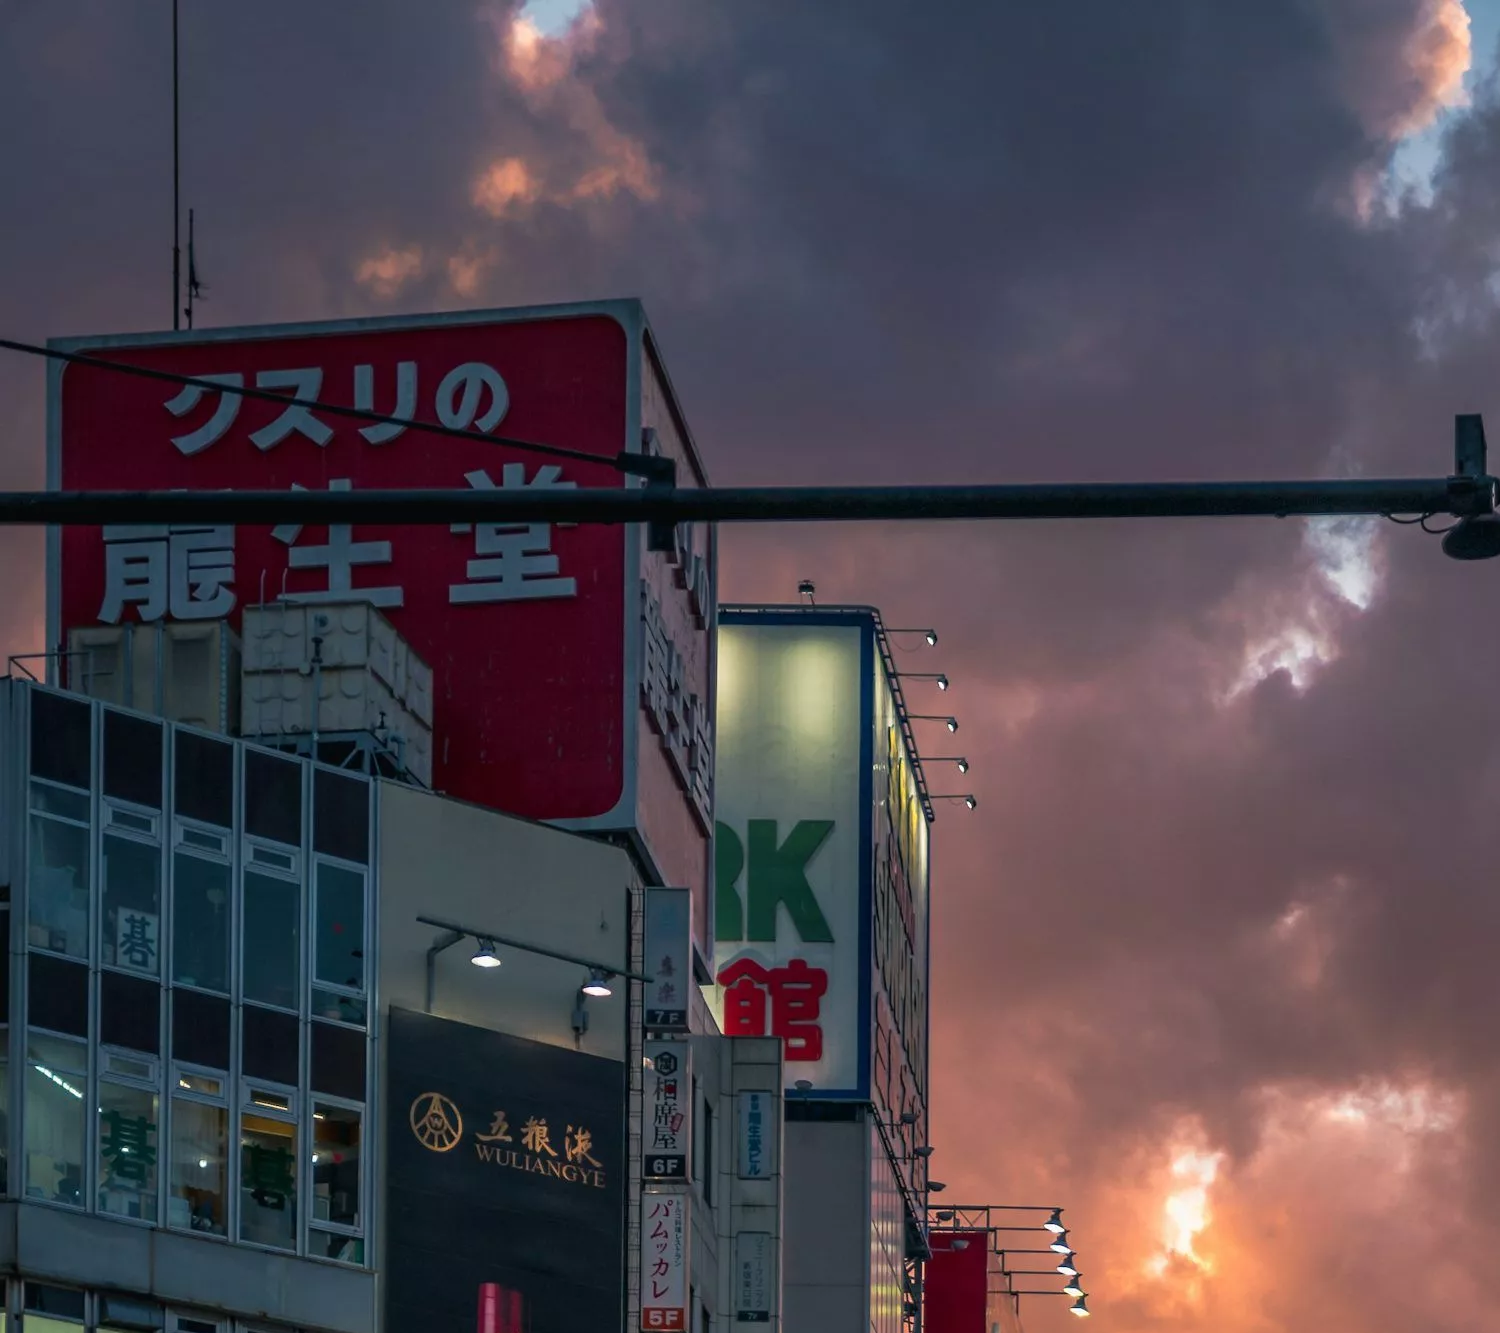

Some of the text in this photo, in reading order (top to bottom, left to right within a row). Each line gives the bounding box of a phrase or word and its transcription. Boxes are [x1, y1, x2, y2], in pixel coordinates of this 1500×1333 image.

[162, 360, 512, 457] クスリの
[97, 463, 580, 626] 龍生堂
[654, 1010, 680, 1024] 7F
[717, 957, 829, 1062] 館
[475, 1110, 604, 1169] 五粮液
[652, 1076, 680, 1151] 相席屋
[475, 1143, 607, 1189] WULIANGYE
[652, 1158, 679, 1175] 6F
[648, 1199, 674, 1299] パムッカレ
[648, 1310, 679, 1327] 5F
